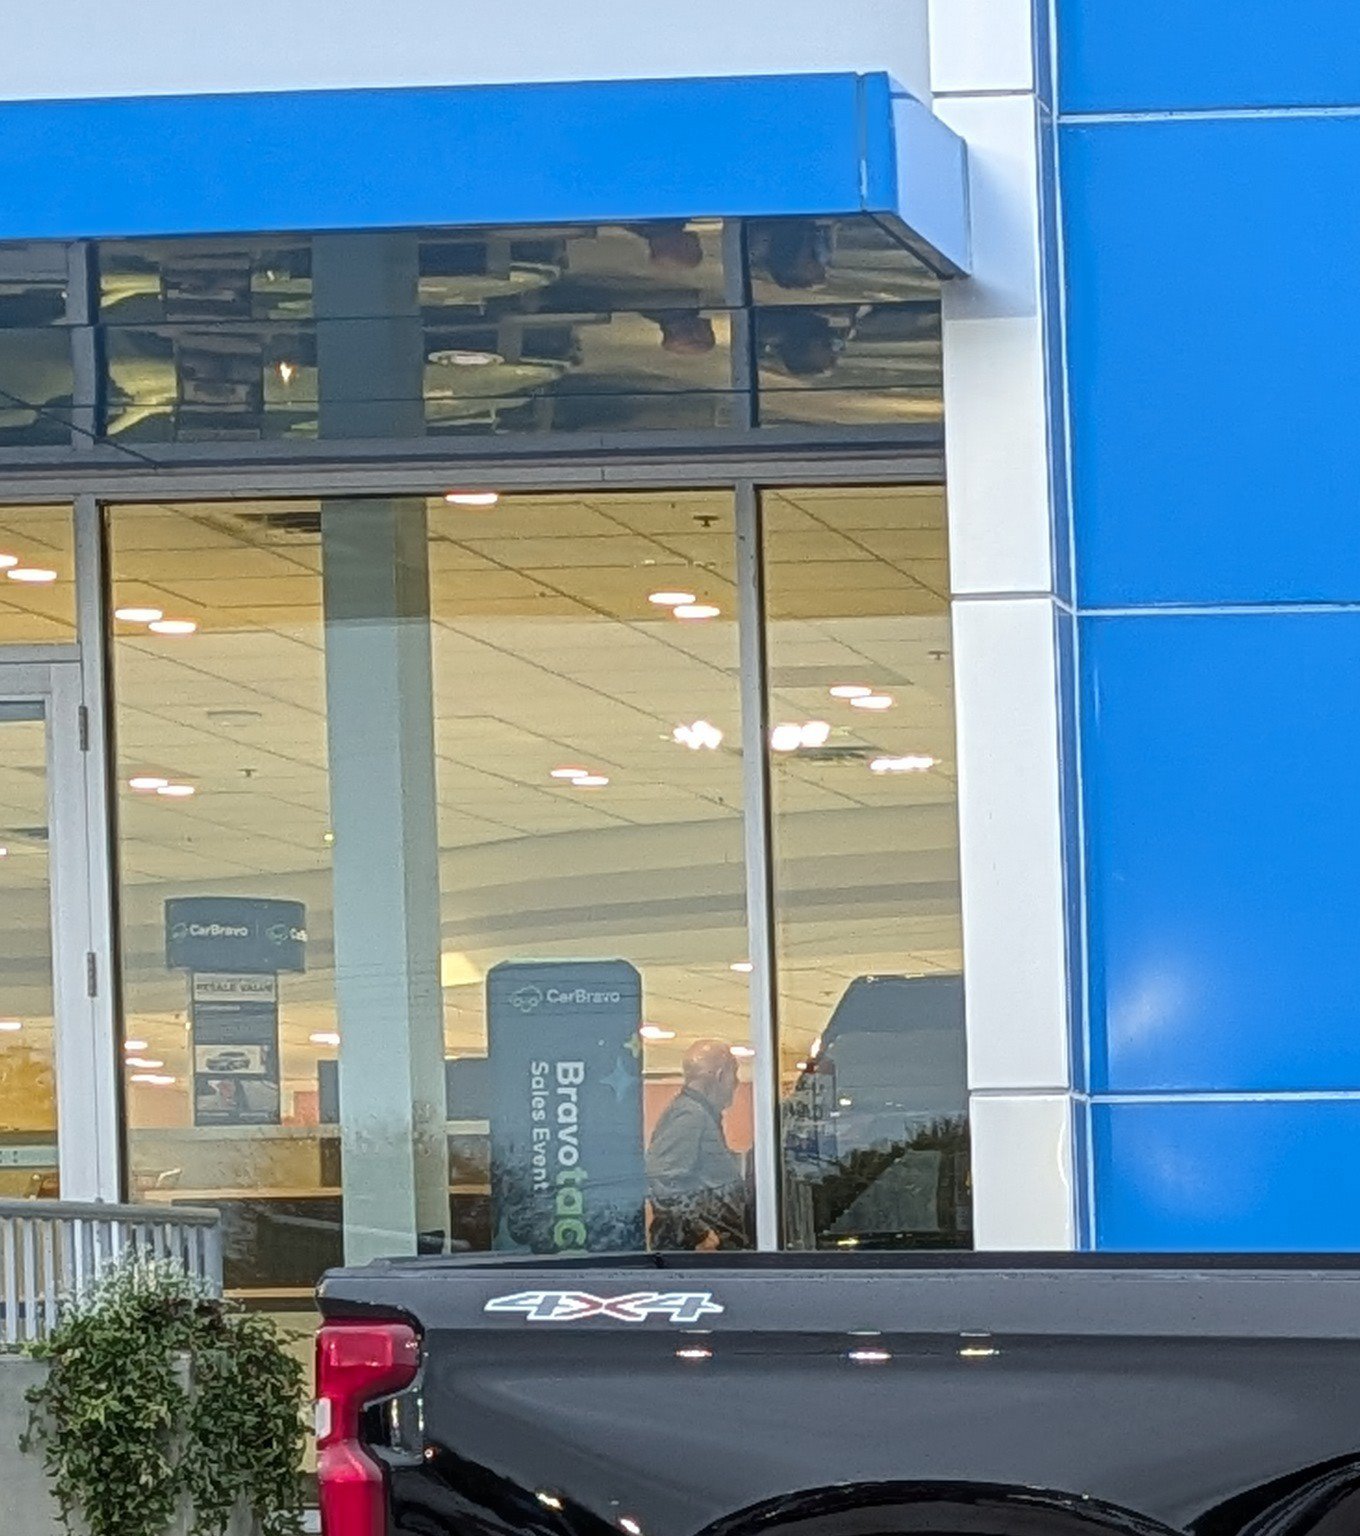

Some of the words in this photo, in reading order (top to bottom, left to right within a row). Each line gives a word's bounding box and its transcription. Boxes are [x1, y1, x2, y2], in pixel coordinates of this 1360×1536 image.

[189, 923, 249, 937] CarBravo
[546, 987, 621, 1004] CarBravo
[531, 1060, 550, 1121] Sales
[532, 1125, 550, 1191] Event
